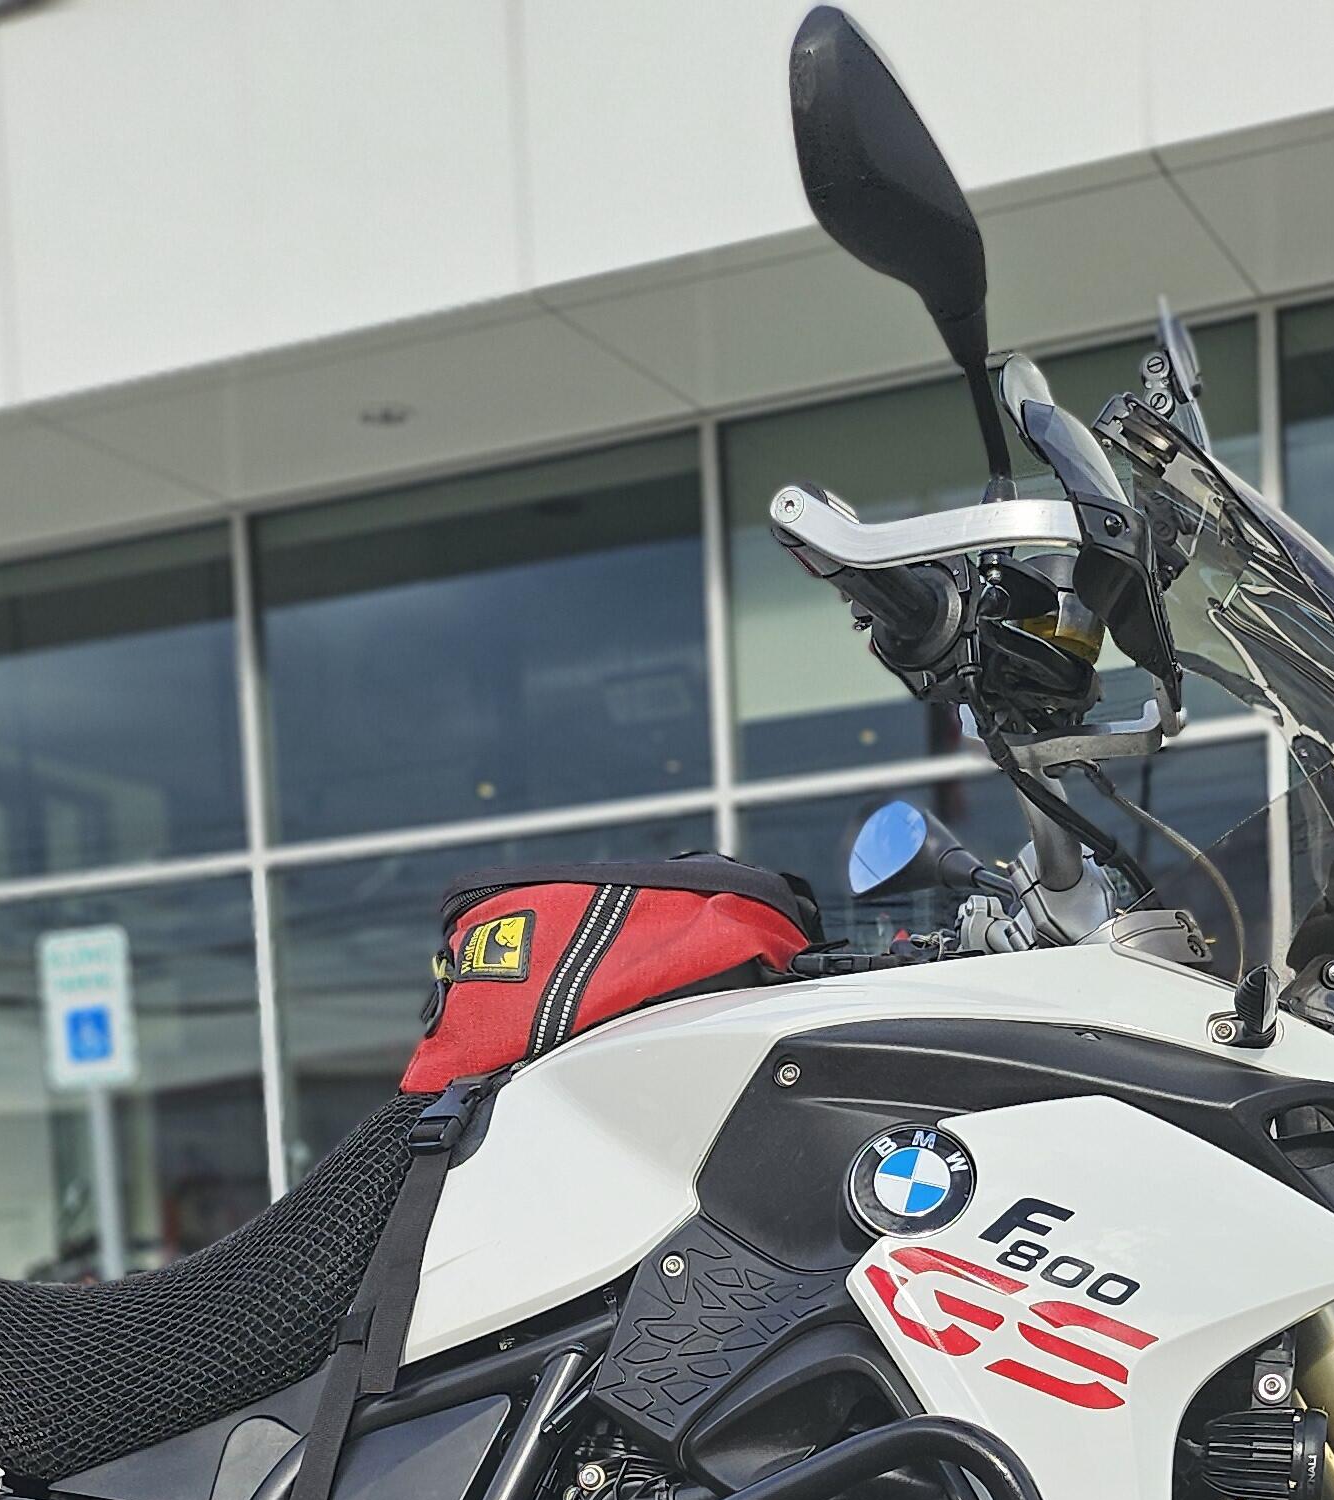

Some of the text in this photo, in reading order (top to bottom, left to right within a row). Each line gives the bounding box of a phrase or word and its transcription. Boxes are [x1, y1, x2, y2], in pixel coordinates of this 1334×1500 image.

[874, 1130, 969, 1173] BMW
[978, 1197, 1076, 1244] F
[996, 1240, 1140, 1306] 800
[865, 1246, 1159, 1410] GS
